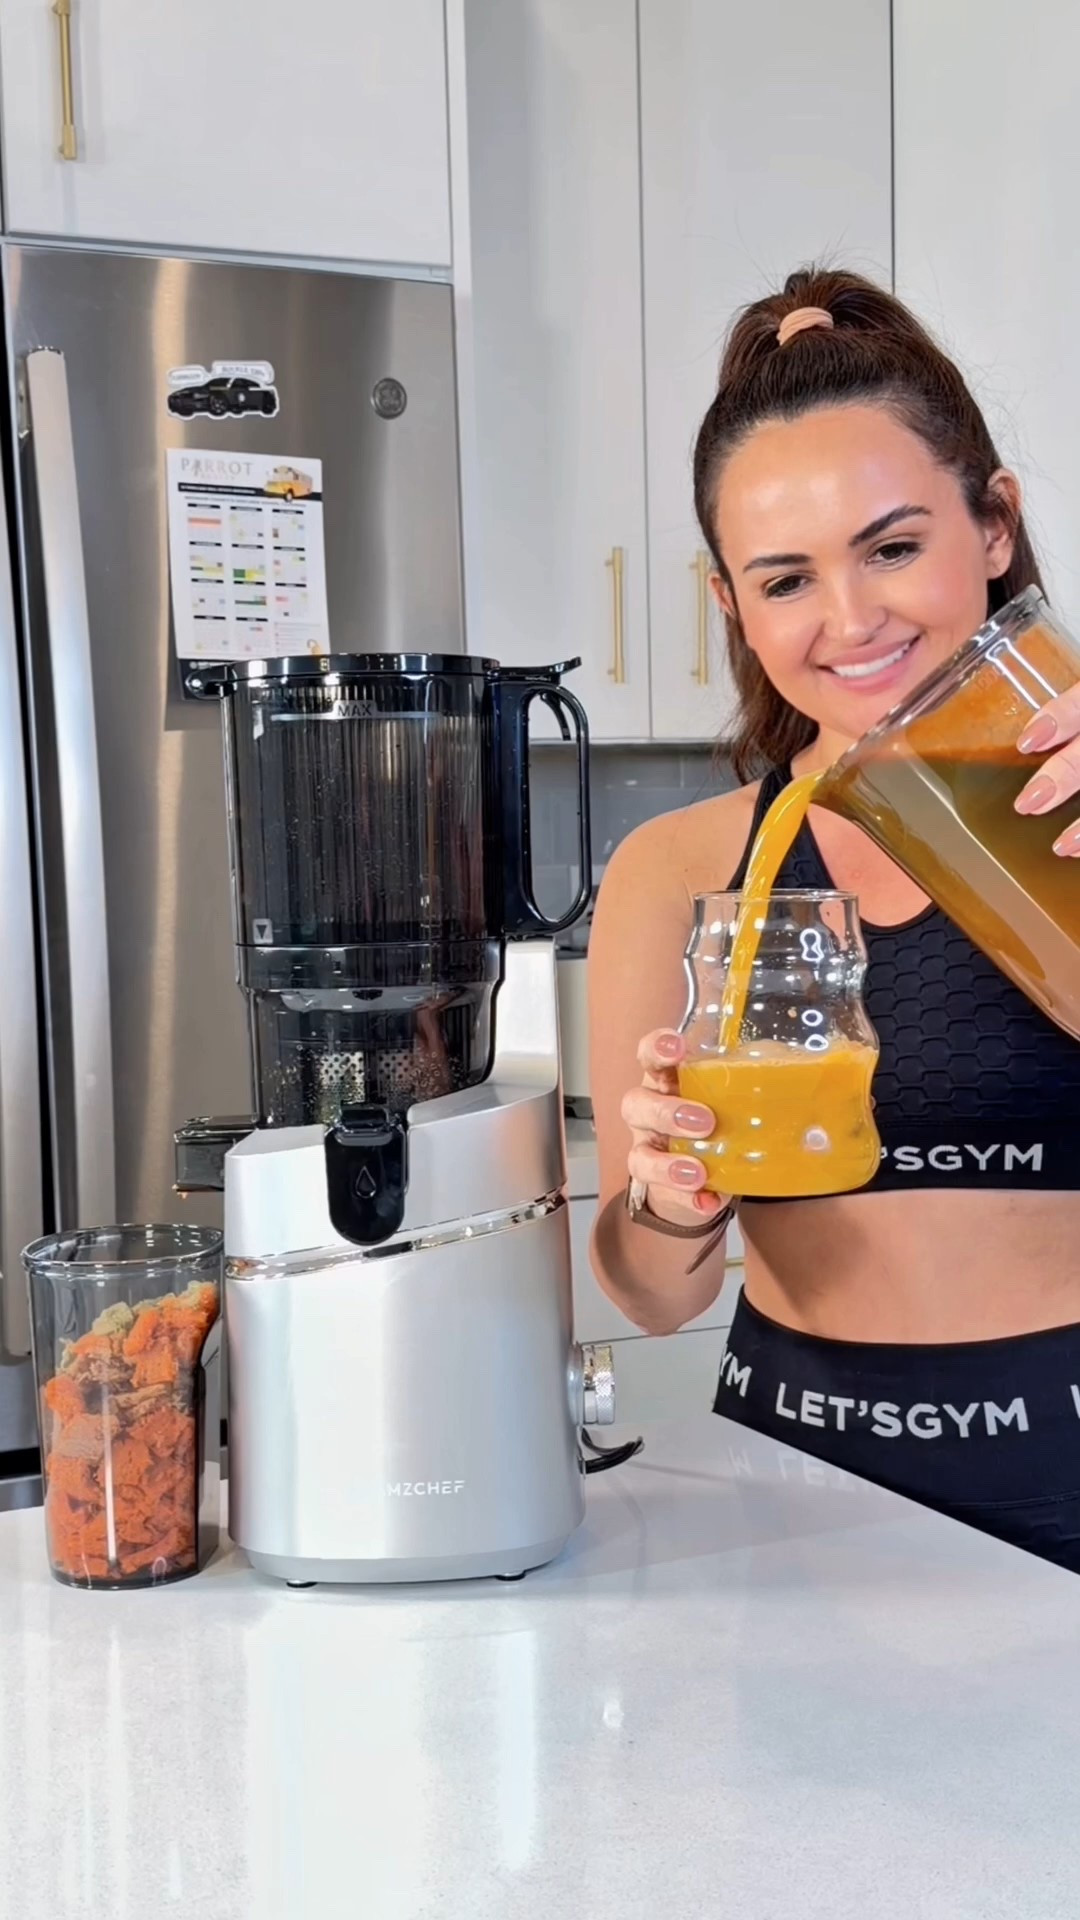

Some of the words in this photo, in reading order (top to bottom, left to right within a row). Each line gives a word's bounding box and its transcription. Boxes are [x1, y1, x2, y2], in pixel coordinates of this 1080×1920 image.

[338, 704, 372, 717] MAX
[880, 1143, 1043, 1171] 'SGYM
[775, 1382, 1030, 1439] LET'SGYM
[384, 1480, 465, 1496] MZCHEF
